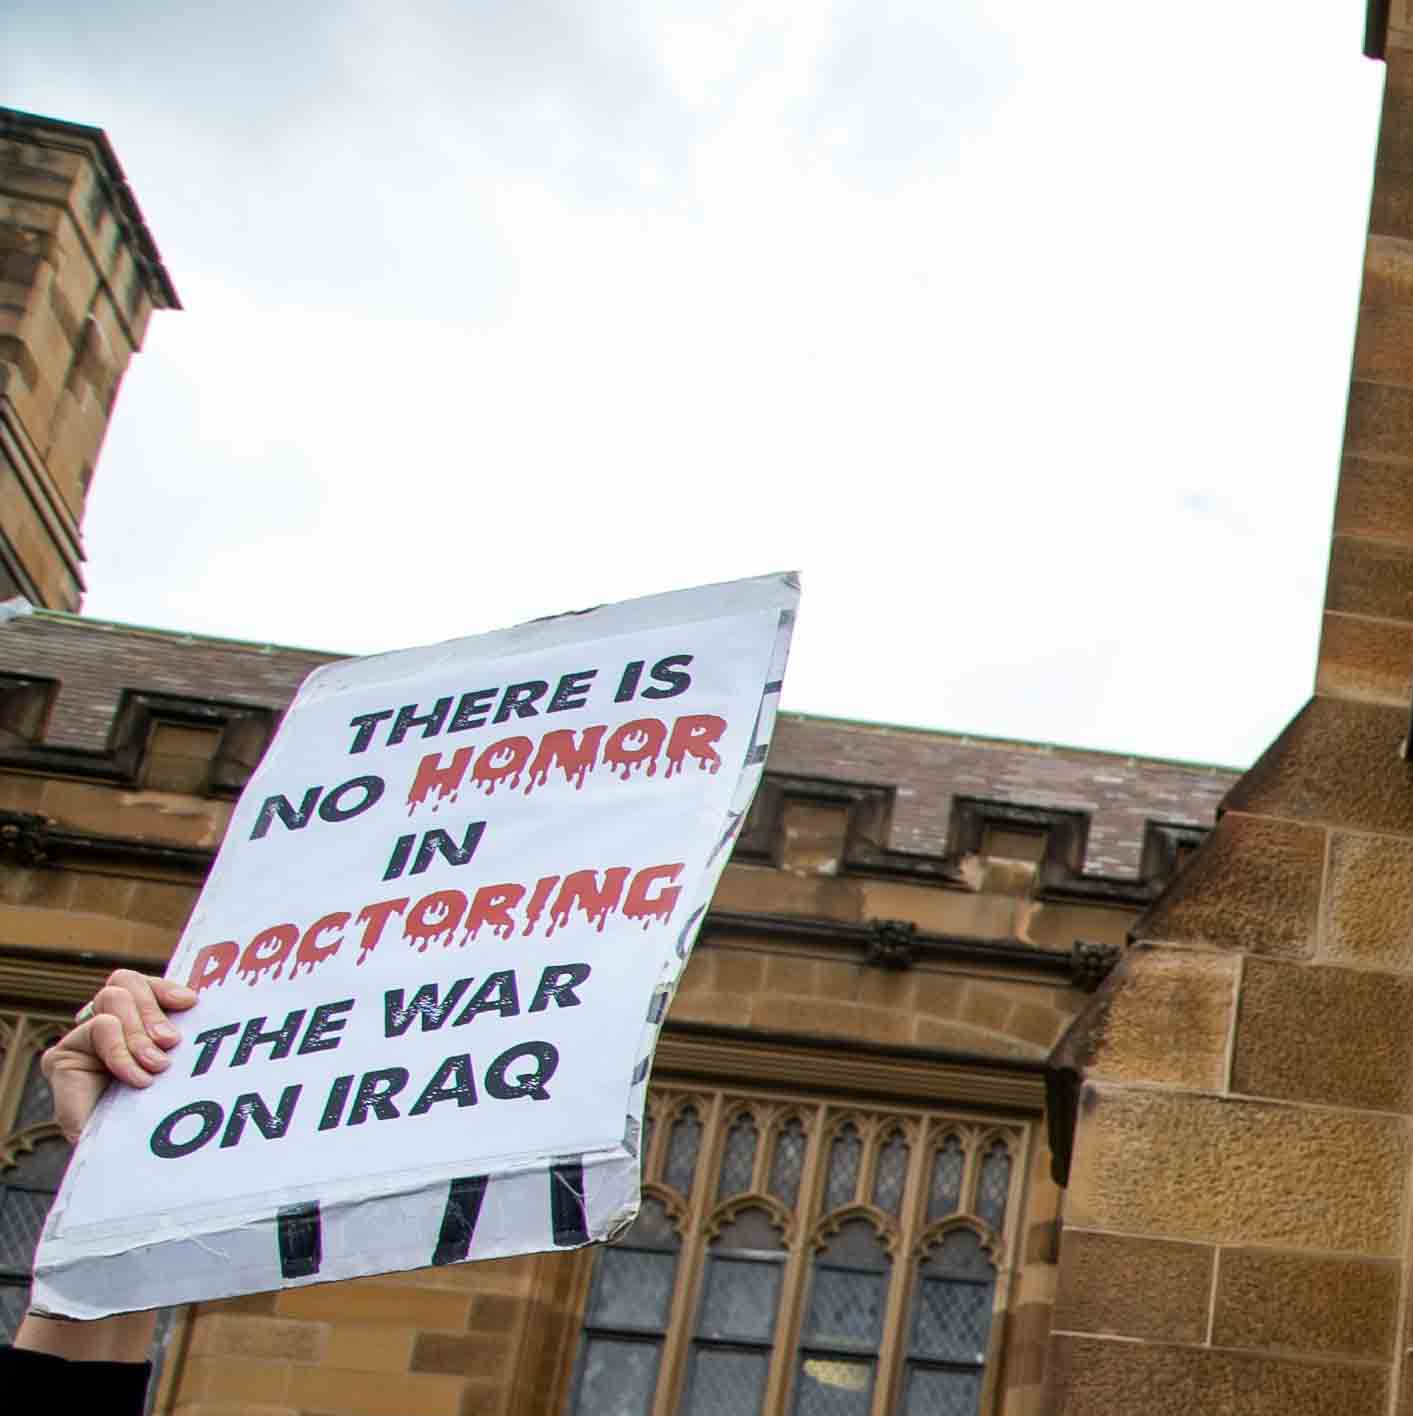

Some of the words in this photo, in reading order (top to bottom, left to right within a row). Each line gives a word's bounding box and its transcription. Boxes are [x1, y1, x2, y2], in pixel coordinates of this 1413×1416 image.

[347, 669, 597, 755] THERE
[613, 653, 694, 704] IS
[248, 774, 386, 842] NO
[404, 713, 730, 816] HONOR
[382, 821, 487, 881] IN
[188, 863, 686, 992] DOCTORING
[190, 998, 354, 1079] THE
[384, 962, 592, 1037] WAR
[149, 1084, 302, 1160] ON
[317, 1040, 560, 1131] IRAQ
